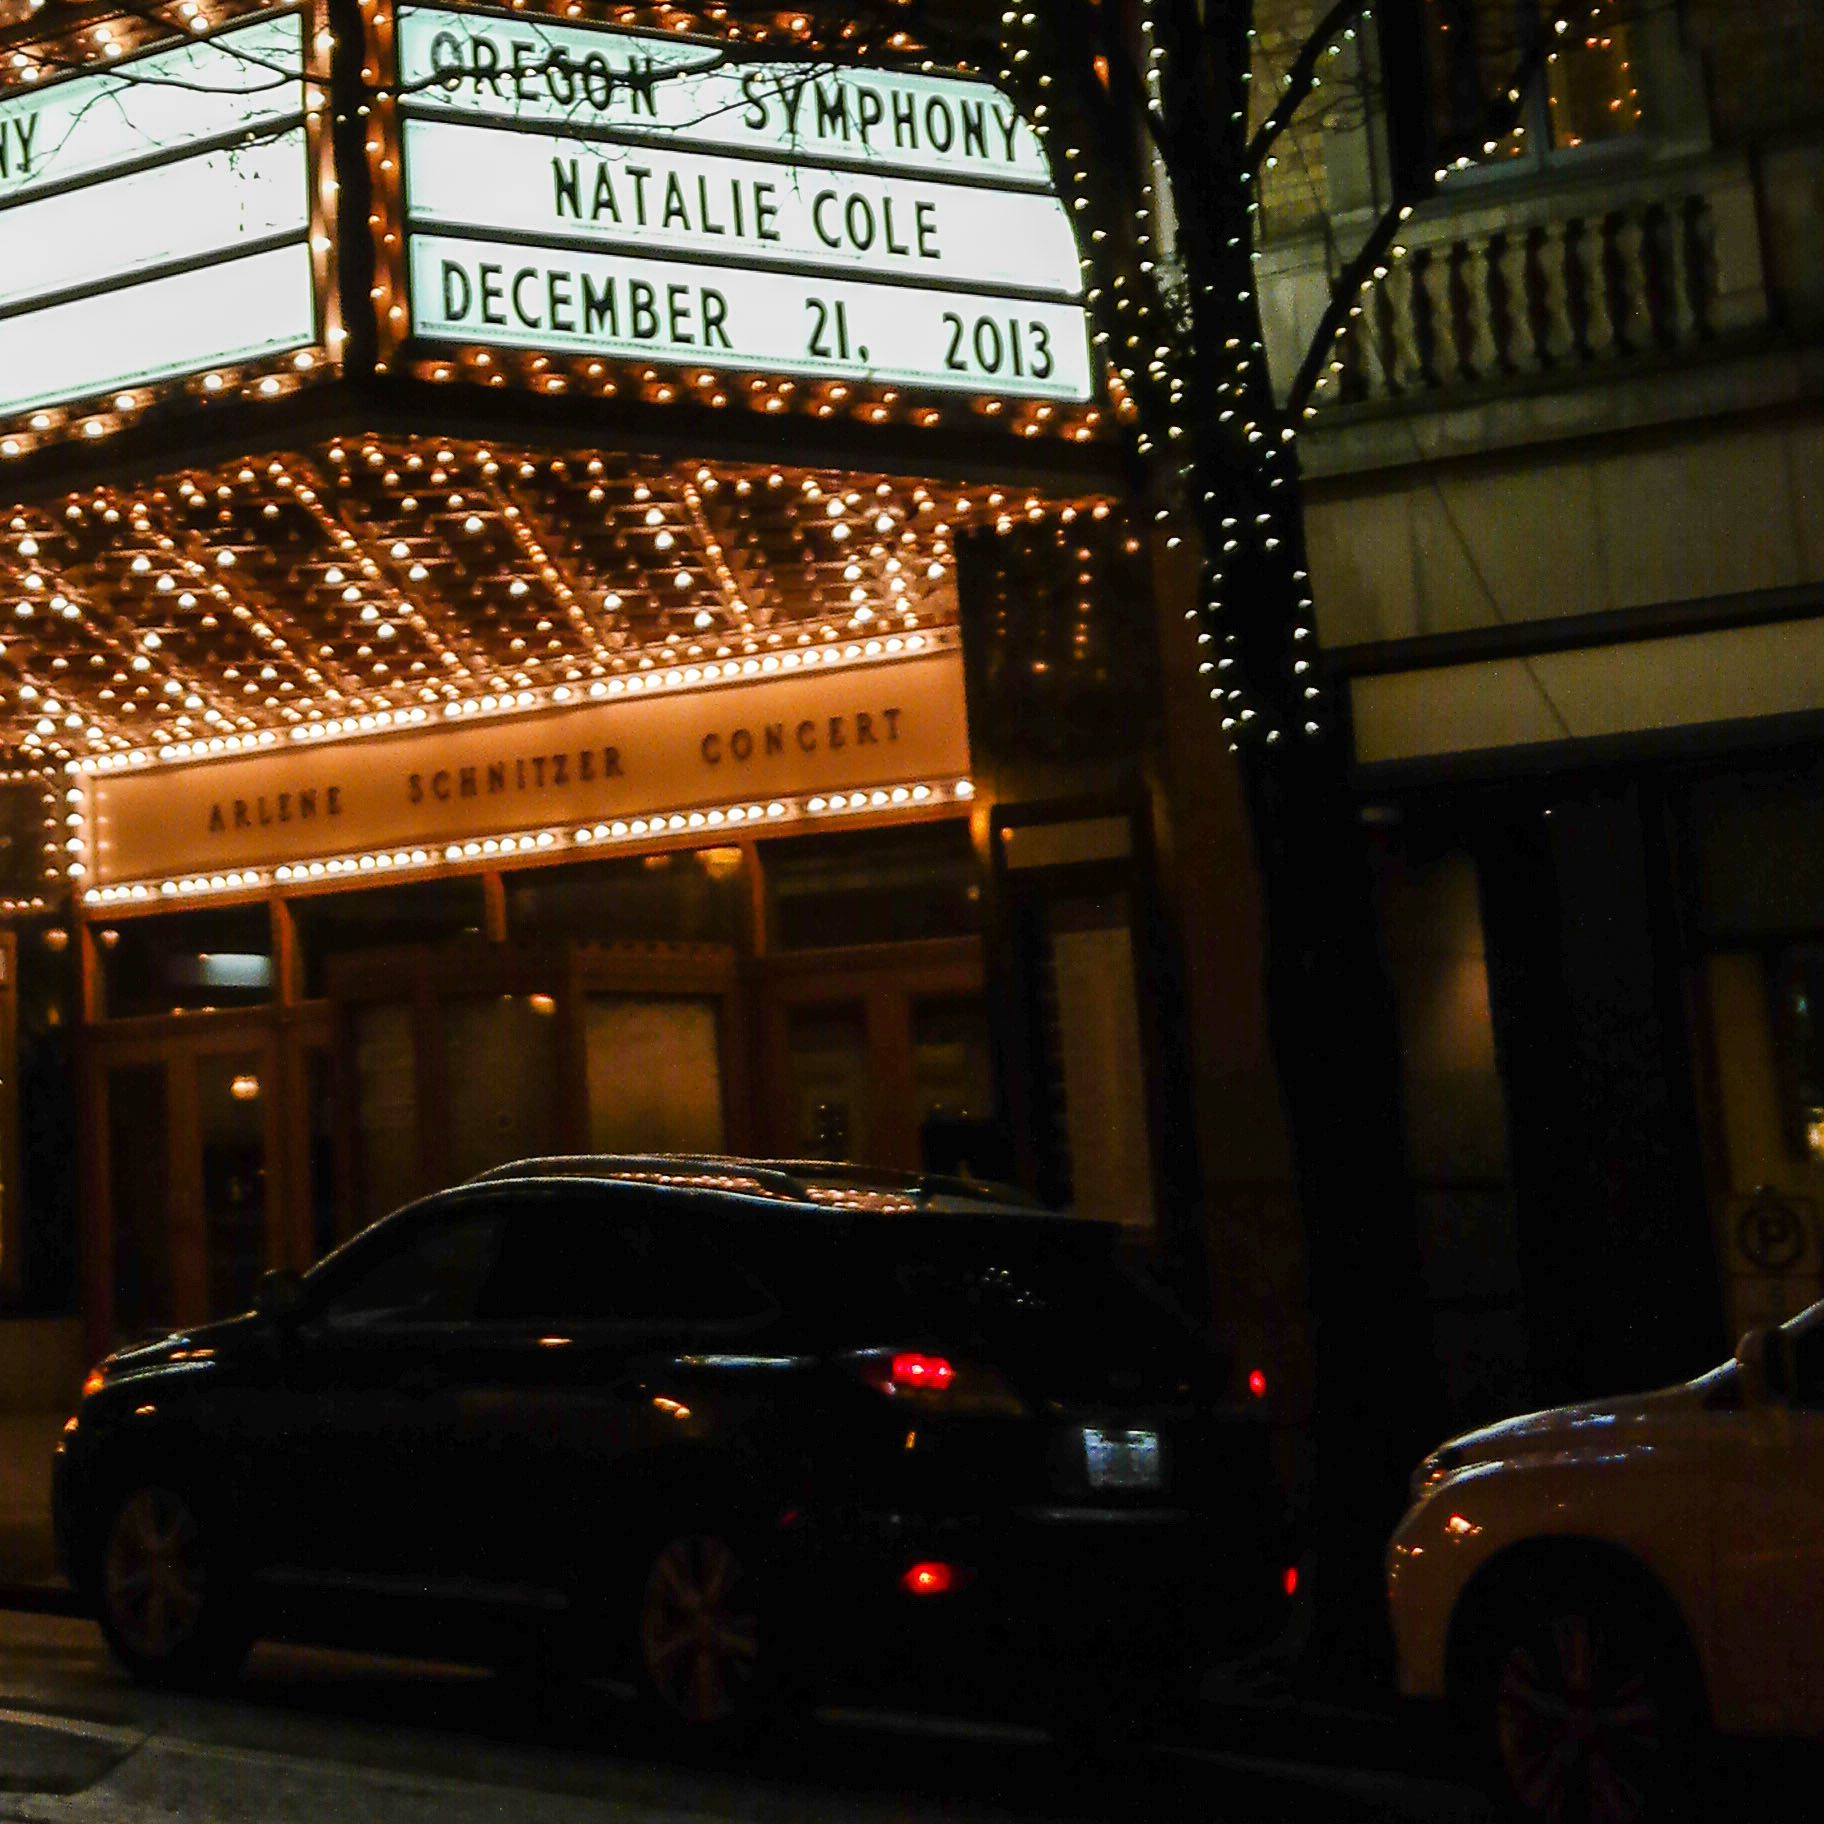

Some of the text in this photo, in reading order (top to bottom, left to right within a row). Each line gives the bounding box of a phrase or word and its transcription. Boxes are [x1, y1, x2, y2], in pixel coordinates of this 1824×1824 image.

[430, 30, 1020, 164] OREGON SYMPHONY
[552, 156, 943, 260] NATALIE COLE
[441, 258, 1056, 380] DECEMBER 21, 2013
[208, 707, 902, 832] ARLENE SCHNITZER CONCERT
